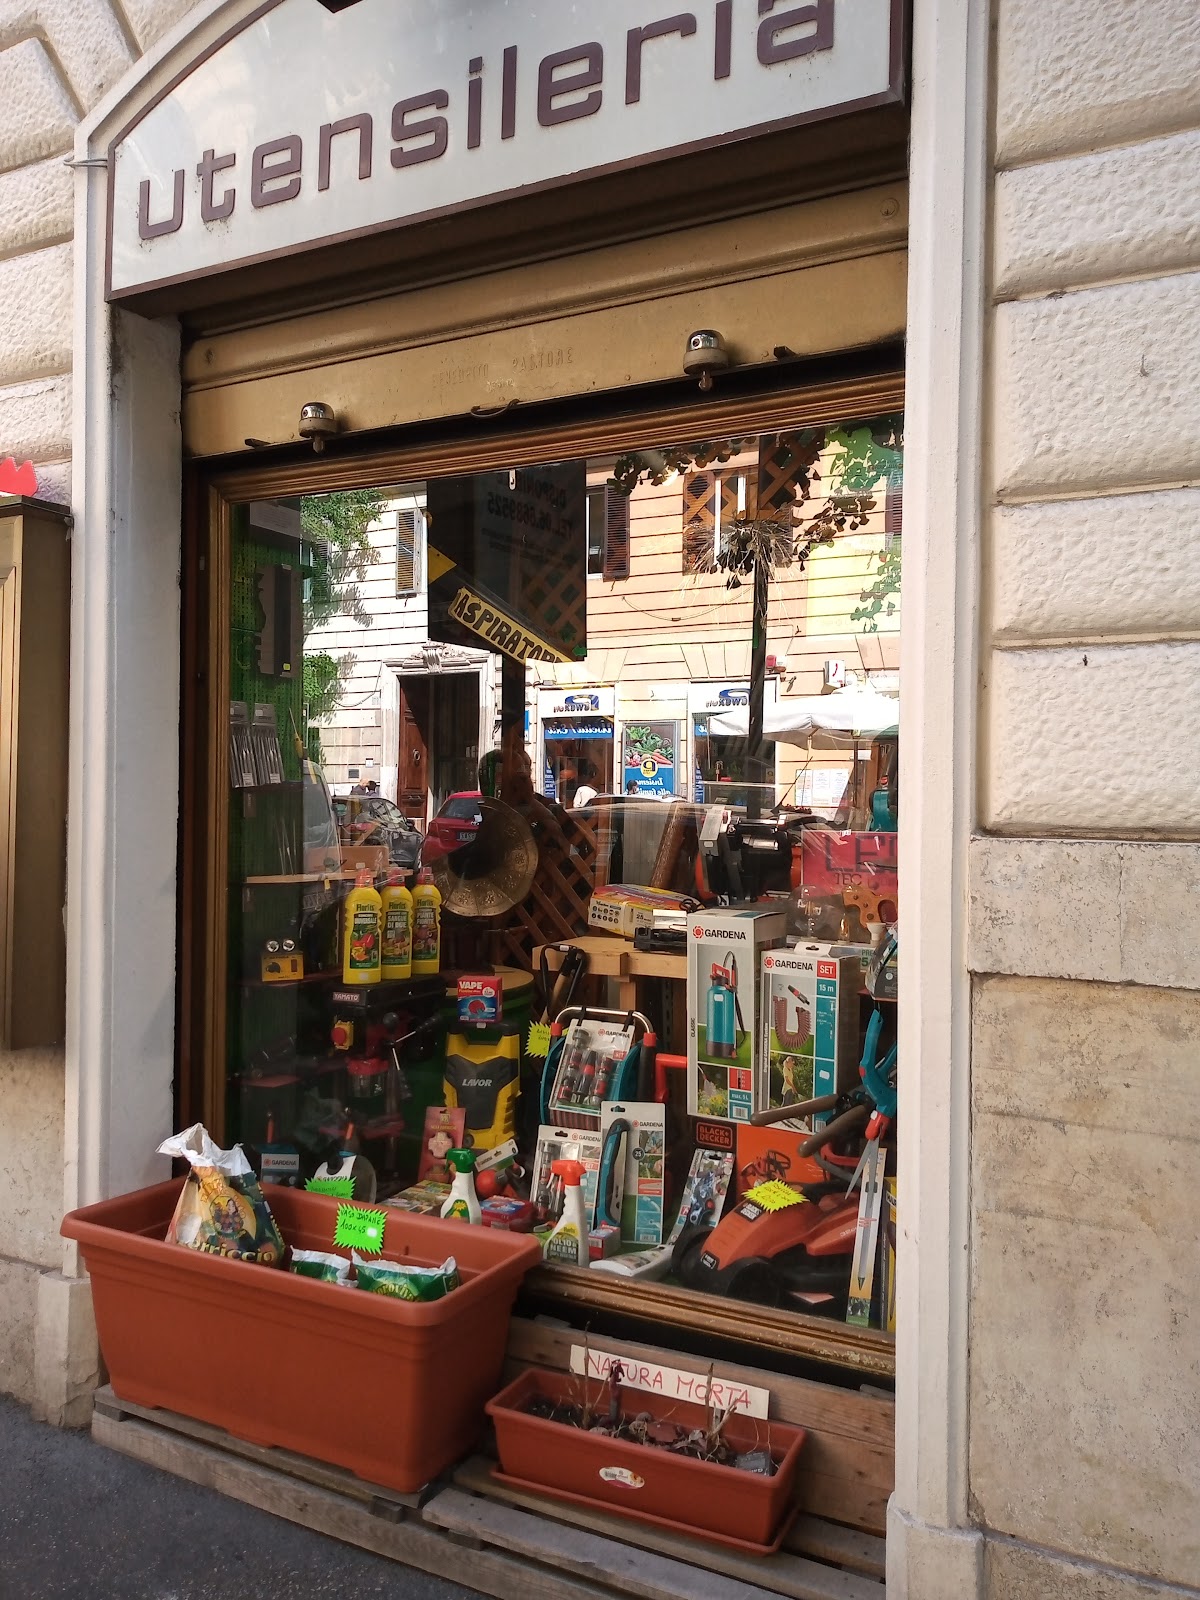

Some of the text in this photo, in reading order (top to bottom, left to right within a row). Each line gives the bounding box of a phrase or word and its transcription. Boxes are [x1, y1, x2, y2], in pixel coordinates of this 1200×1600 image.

[138, 0, 834, 241] utensileria
[704, 928, 747, 941] GARDENA
[774, 957, 814, 972] GARDENA
[819, 964, 834, 975] SET
[458, 981, 484, 990] VAPE
[819, 984, 827, 992] 15
[461, 1077, 493, 1088] LAVOR
[699, 1133, 730, 1145] DECKER
[553, 1238, 572, 1247] OLIO
[550, 1244, 577, 1255] NEEM
[587, 1351, 752, 1410] NATURA MORTA
